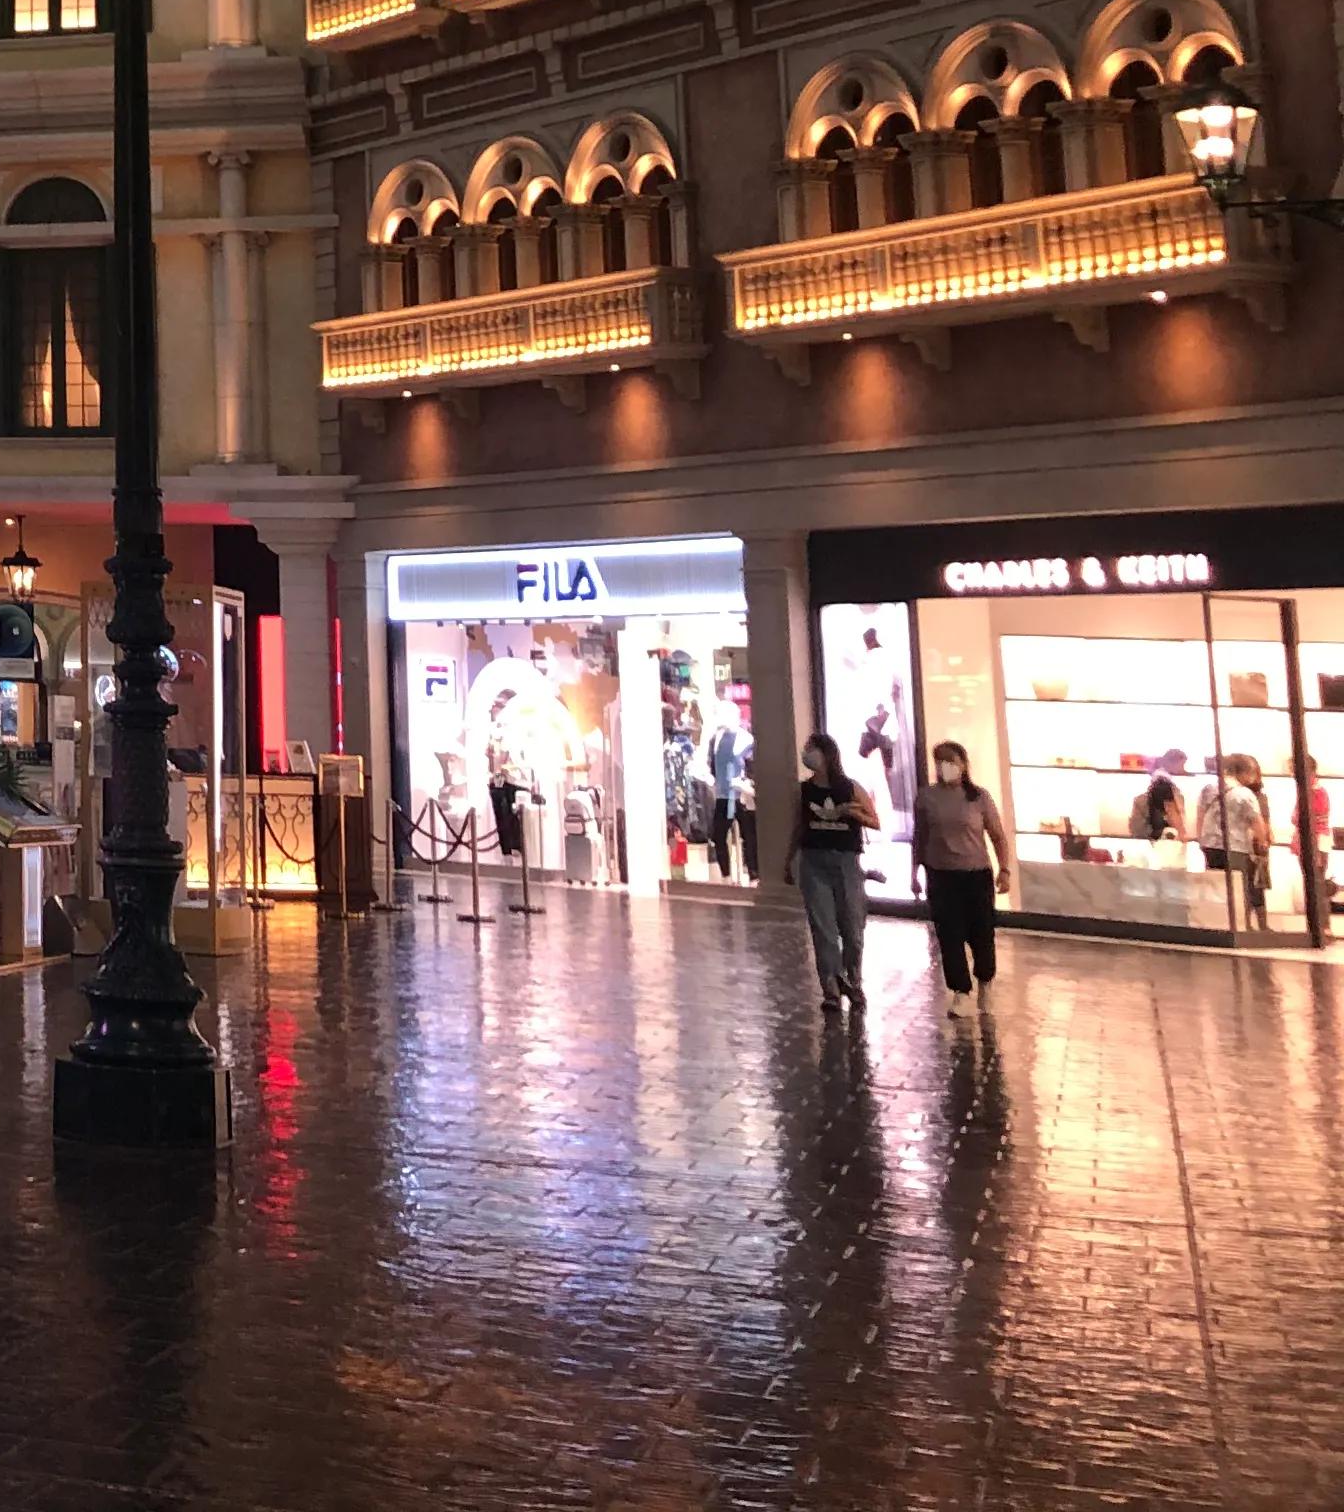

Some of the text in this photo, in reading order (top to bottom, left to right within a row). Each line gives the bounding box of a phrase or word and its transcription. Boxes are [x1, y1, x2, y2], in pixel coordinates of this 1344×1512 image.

[516, 559, 598, 603] FILA
[945, 553, 1209, 592] CHARLES & KEITH
